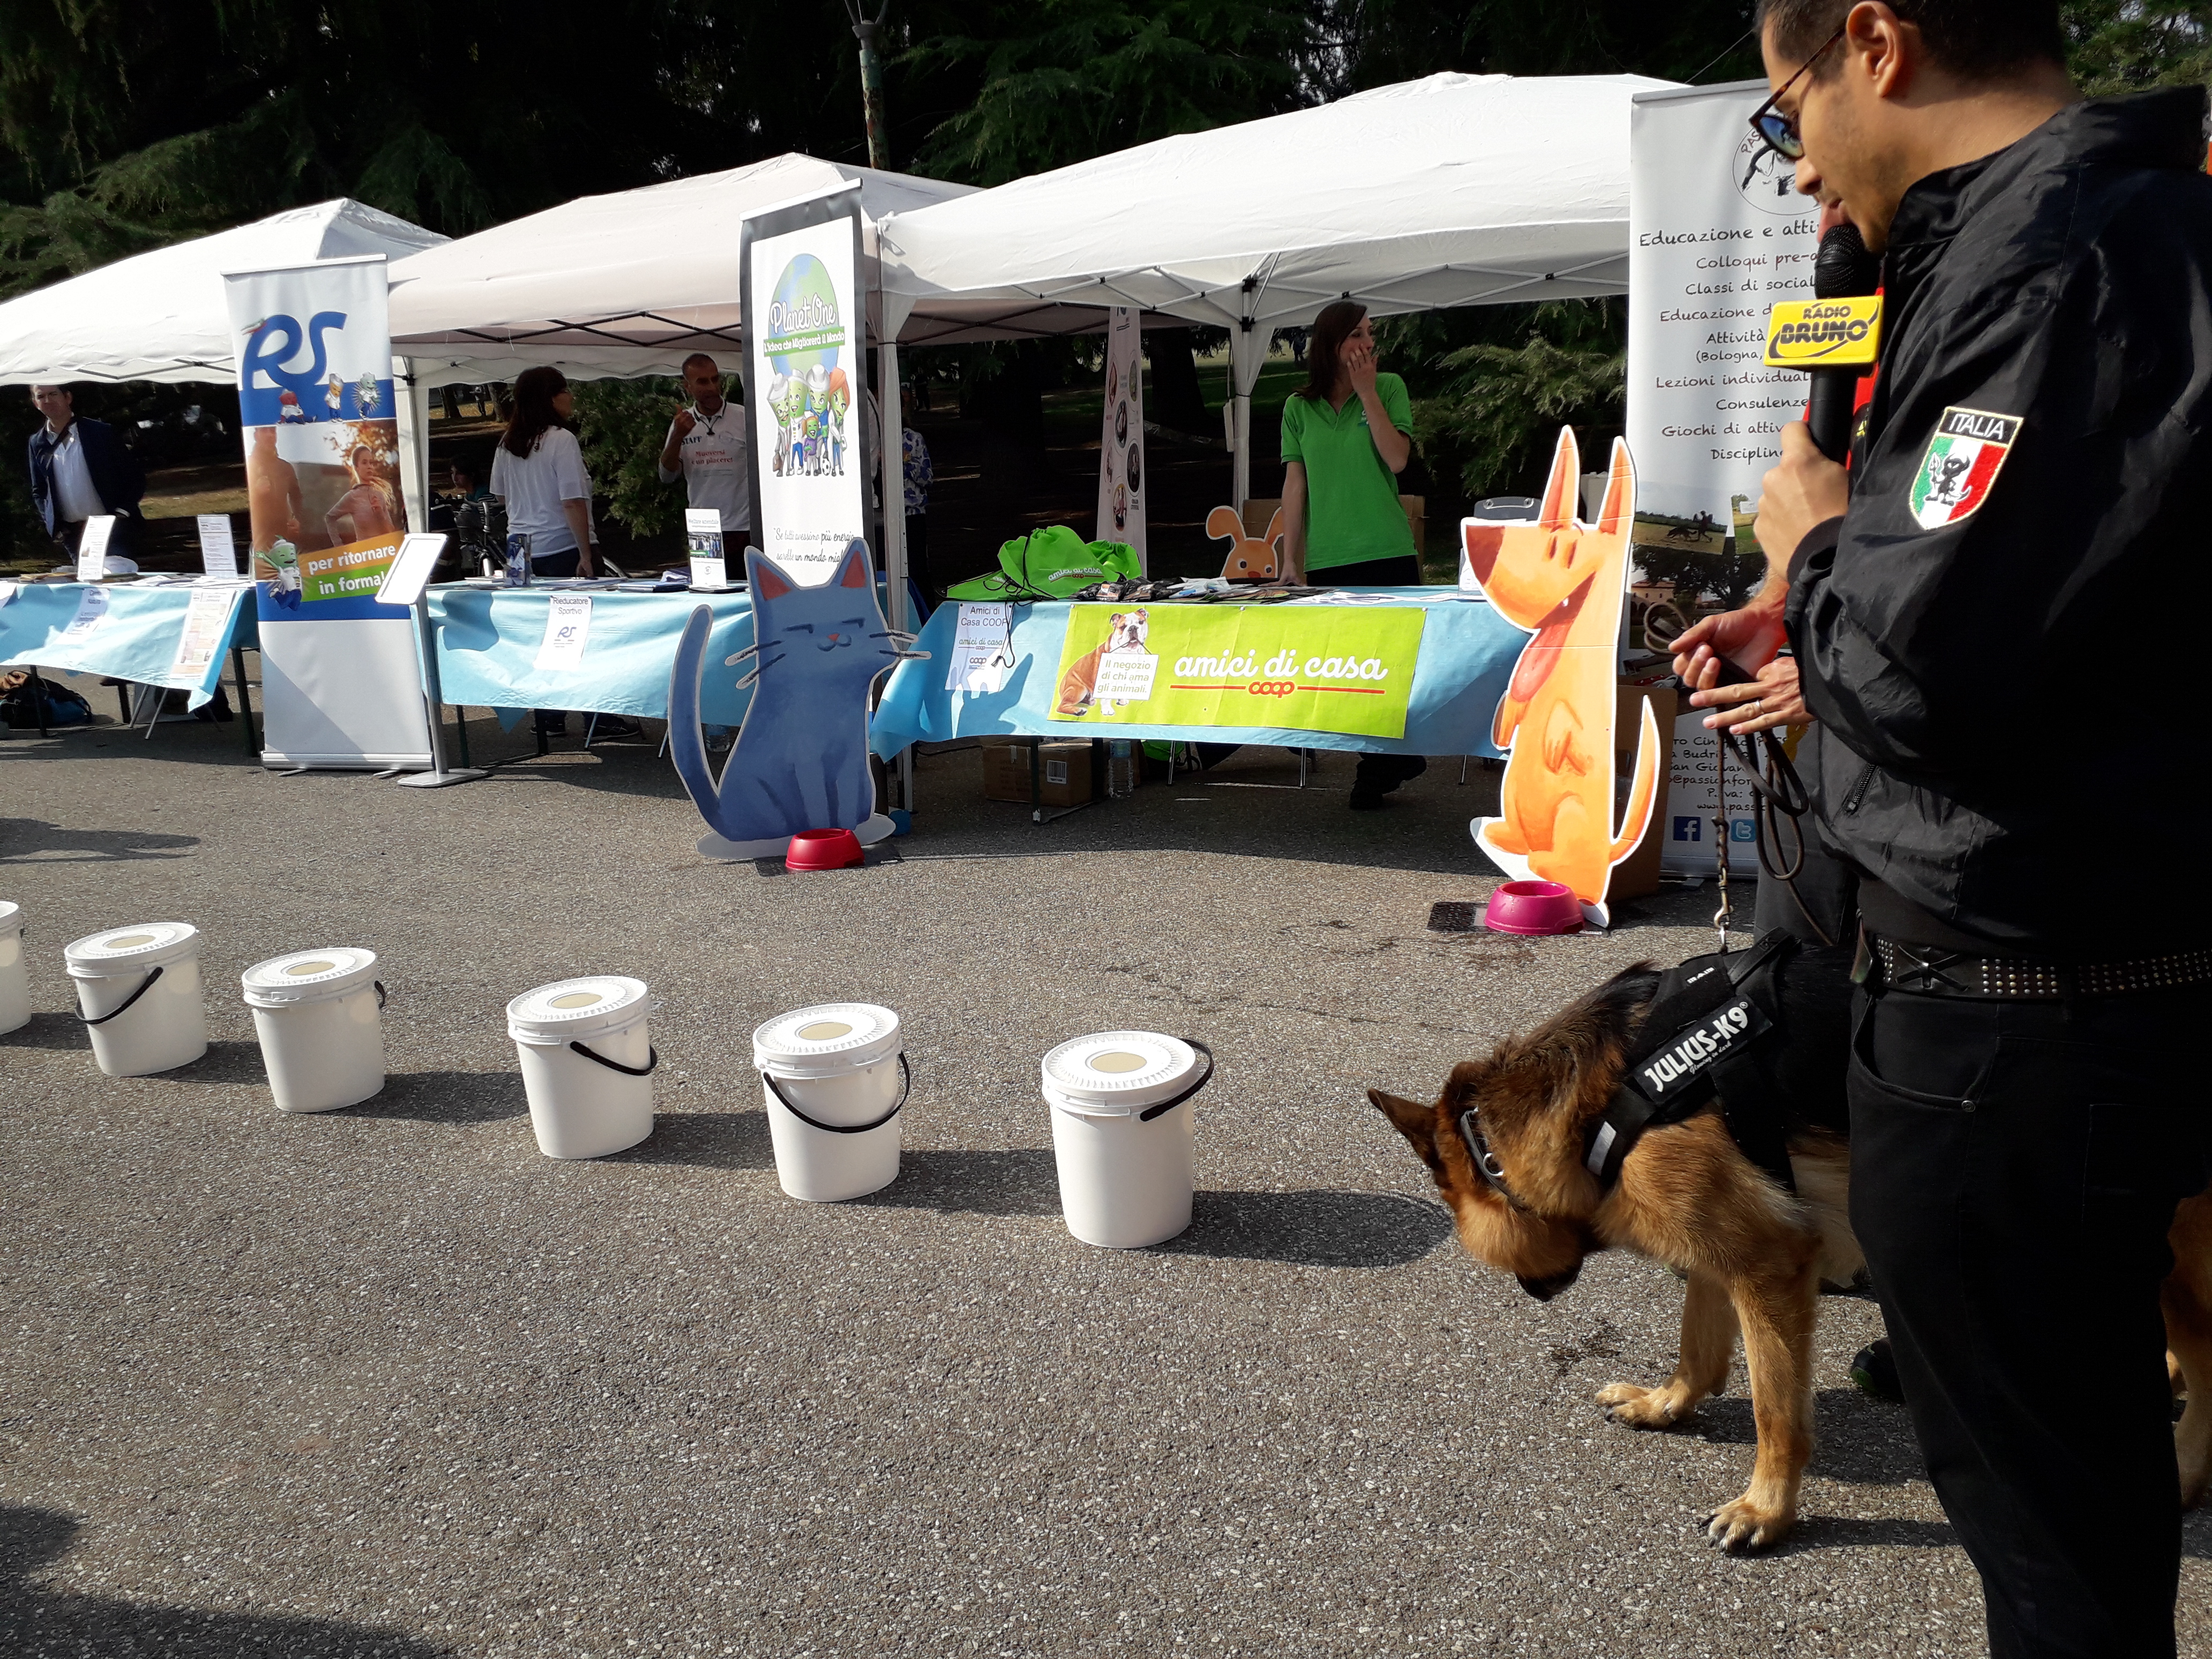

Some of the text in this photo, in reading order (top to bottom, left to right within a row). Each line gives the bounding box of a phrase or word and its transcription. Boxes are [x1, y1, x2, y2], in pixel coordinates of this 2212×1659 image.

[1640, 219, 1820, 246] Educazione e atti
[1696, 254, 1768, 273] Colloqui
[1686, 282, 1734, 295] Classi
[1741, 279, 1758, 291] di
[770, 292, 837, 334] Planet One
[1660, 308, 1755, 322] Educazione
[1803, 305, 1851, 320] RADIO
[827, 331, 845, 343] Mondo
[1706, 328, 1766, 344] Attività
[1780, 319, 1869, 345] BRUNO
[241, 311, 348, 390] RS
[1696, 350, 1763, 363] (Bologna,
[1656, 375, 1715, 388] Lezioni
[1716, 397, 1809, 410] Consulenze
[1661, 424, 1717, 437] Giochi
[1724, 422, 1742, 434] di
[1948, 413, 2005, 440] ITALIA
[682, 436, 702, 445] STAFF
[308, 544, 397, 576] per ritornare
[318, 580, 335, 595] in
[553, 597, 589, 605] Rieducatore
[557, 607, 583, 616] Sportivo
[970, 606, 1000, 615] Amici di
[961, 617, 1007, 627] Casa COOP
[959, 637, 978, 645] amici
[978, 637, 987, 645] di
[969, 657, 987, 665] coop
[1105, 659, 1151, 671] Il negozio
[1174, 648, 1389, 681] amici di casa
[1101, 671, 1111, 680] di
[1112, 671, 1127, 681] chi
[1097, 683, 1147, 693] gli animali.
[1247, 681, 1296, 699] coop
